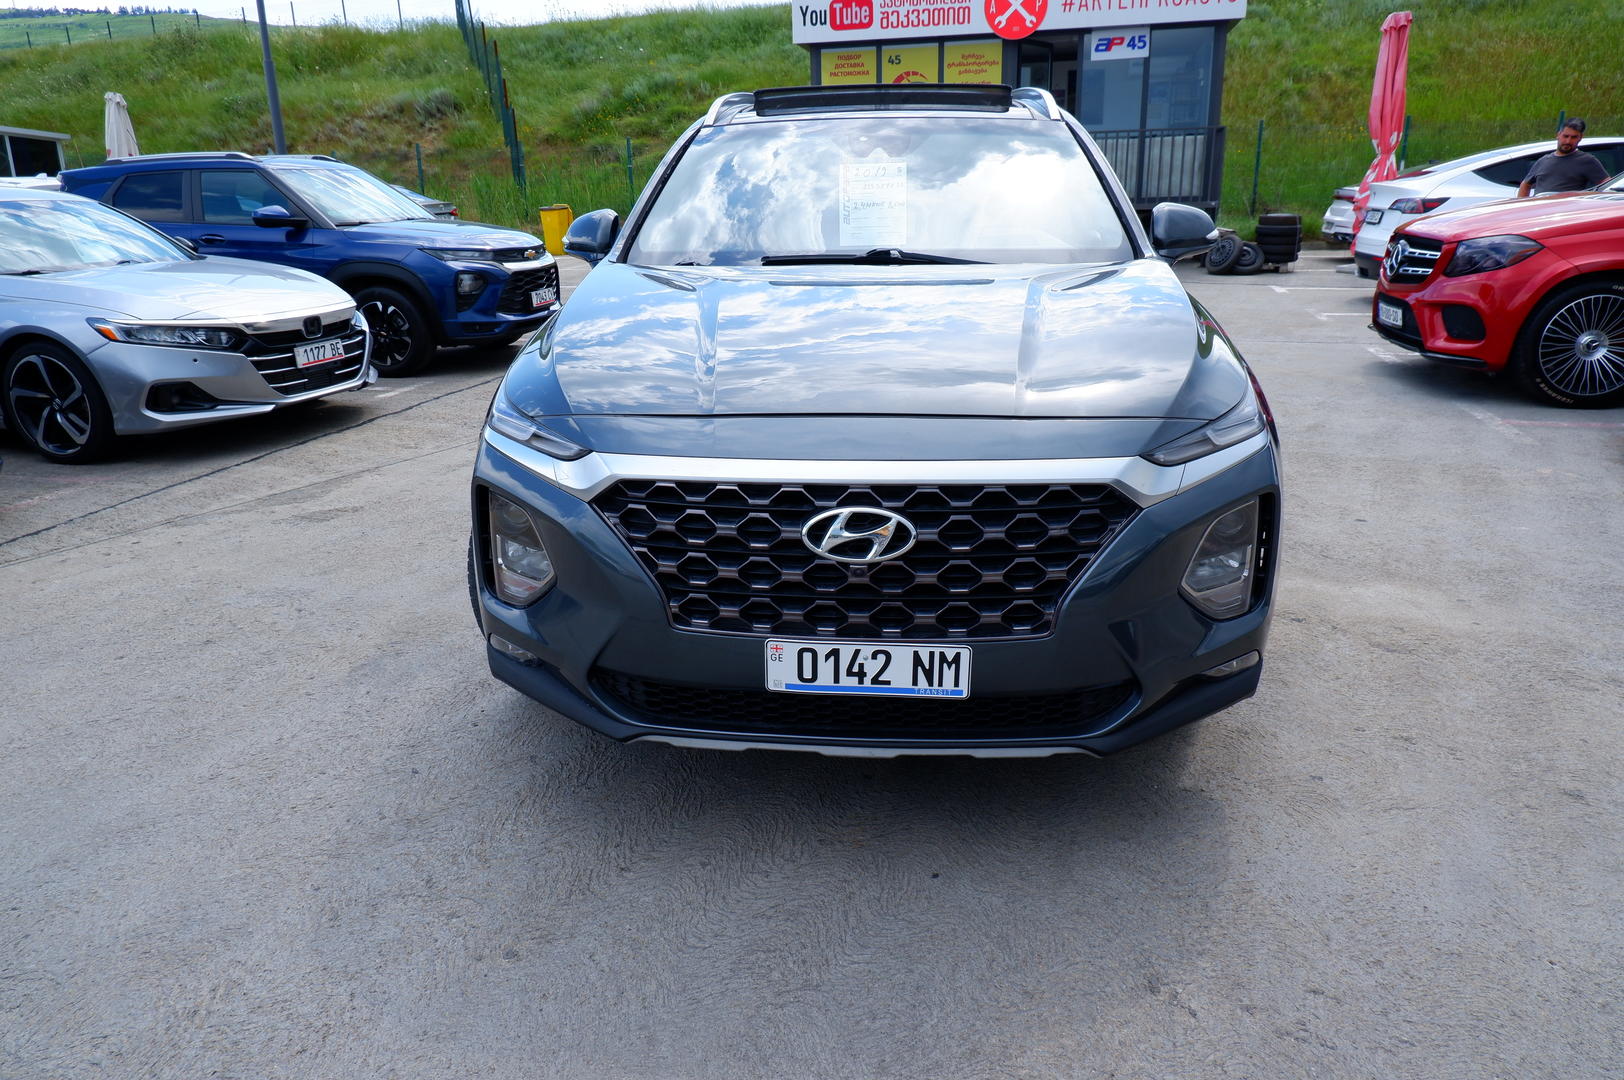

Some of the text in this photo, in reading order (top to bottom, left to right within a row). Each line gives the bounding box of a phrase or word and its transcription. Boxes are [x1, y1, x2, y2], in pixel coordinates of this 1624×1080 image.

[1127, 35, 1147, 50] 45
[888, 54, 902, 65] 45
[303, 345, 326, 362] 1177
[770, 653, 784, 662] GE
[797, 647, 962, 687] 0142 NM
[914, 688, 952, 696] TRANSIT
